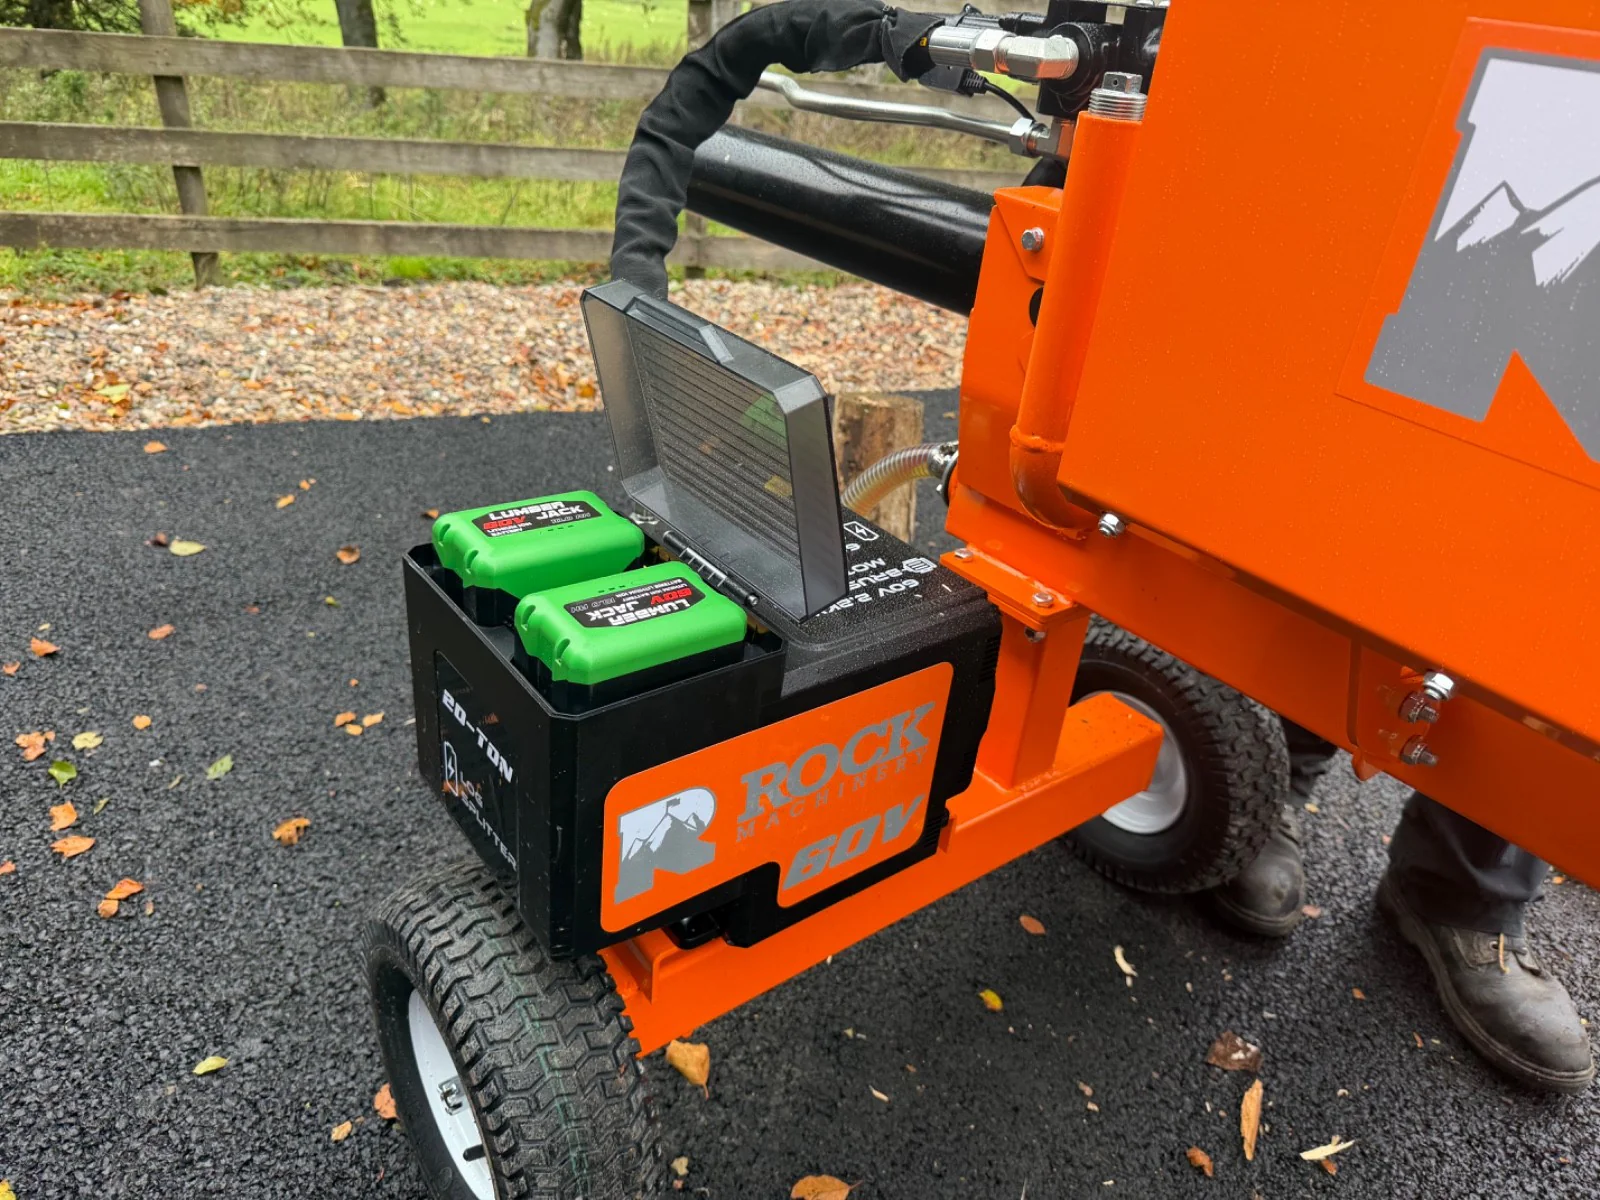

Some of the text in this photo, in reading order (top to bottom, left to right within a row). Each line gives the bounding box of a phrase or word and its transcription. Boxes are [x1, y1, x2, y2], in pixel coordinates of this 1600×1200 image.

[483, 516, 526, 529] 60V
[488, 501, 565, 521] LUMBER
[536, 505, 584, 520] JACK
[585, 601, 639, 621] JACK
[608, 598, 690, 626] LUMBER
[650, 587, 692, 606] 60V
[815, 578, 919, 617] 60V 2.2K
[442, 688, 513, 783] 20-TON
[737, 701, 936, 824] ROCK
[460, 770, 483, 809] LOG
[736, 749, 928, 843] MACHINERY
[461, 791, 517, 872] SPLITTER
[782, 793, 926, 890] 60V
